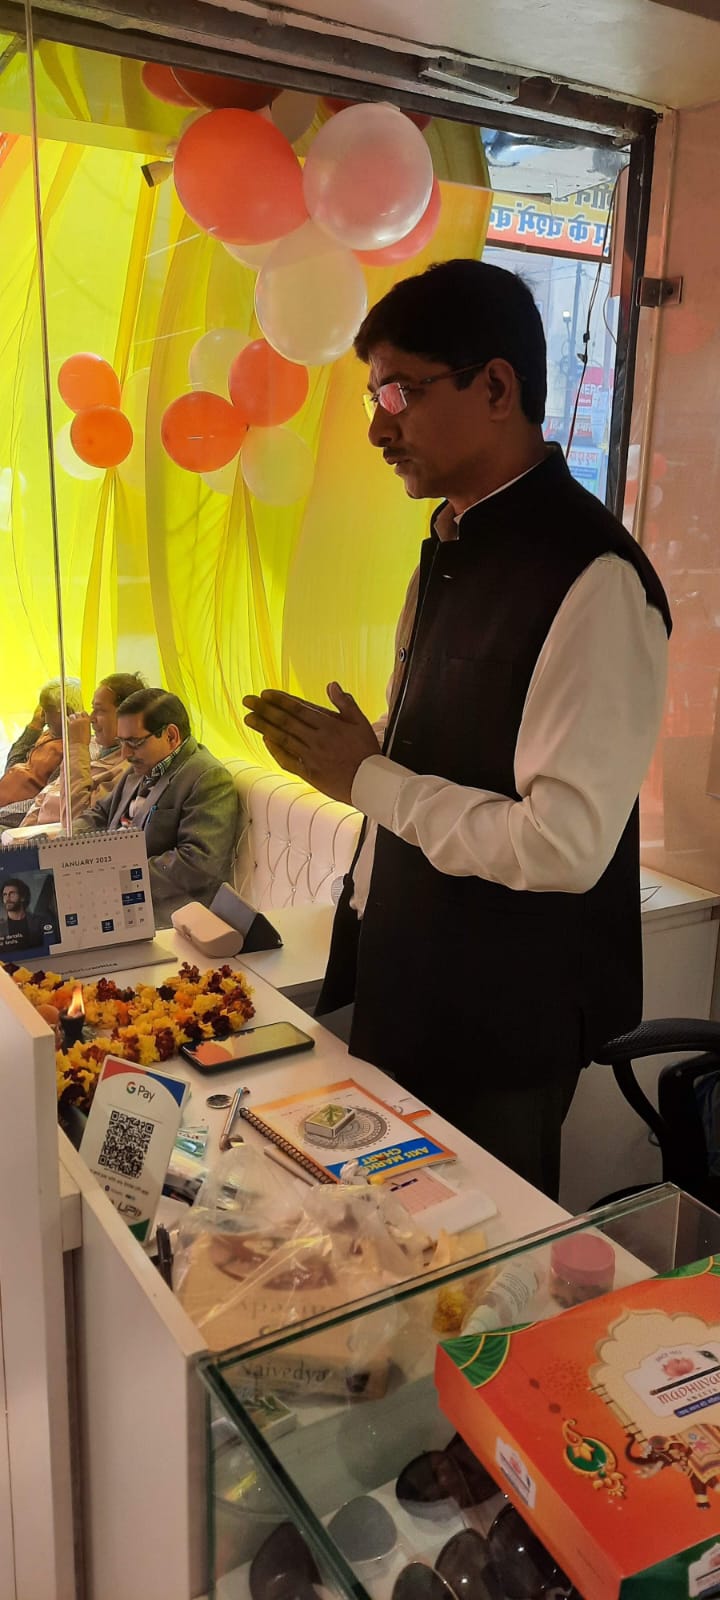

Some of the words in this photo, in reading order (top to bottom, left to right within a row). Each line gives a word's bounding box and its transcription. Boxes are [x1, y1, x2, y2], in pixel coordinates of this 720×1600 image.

[62, 858, 94, 869] JANUARY
[95, 856, 113, 864] 2023
[126, 1081, 136, 1094] G
[137, 1085, 155, 1103] Pay
[361, 1147, 402, 1166] CHART
[404, 1146, 429, 1160] AXIS
